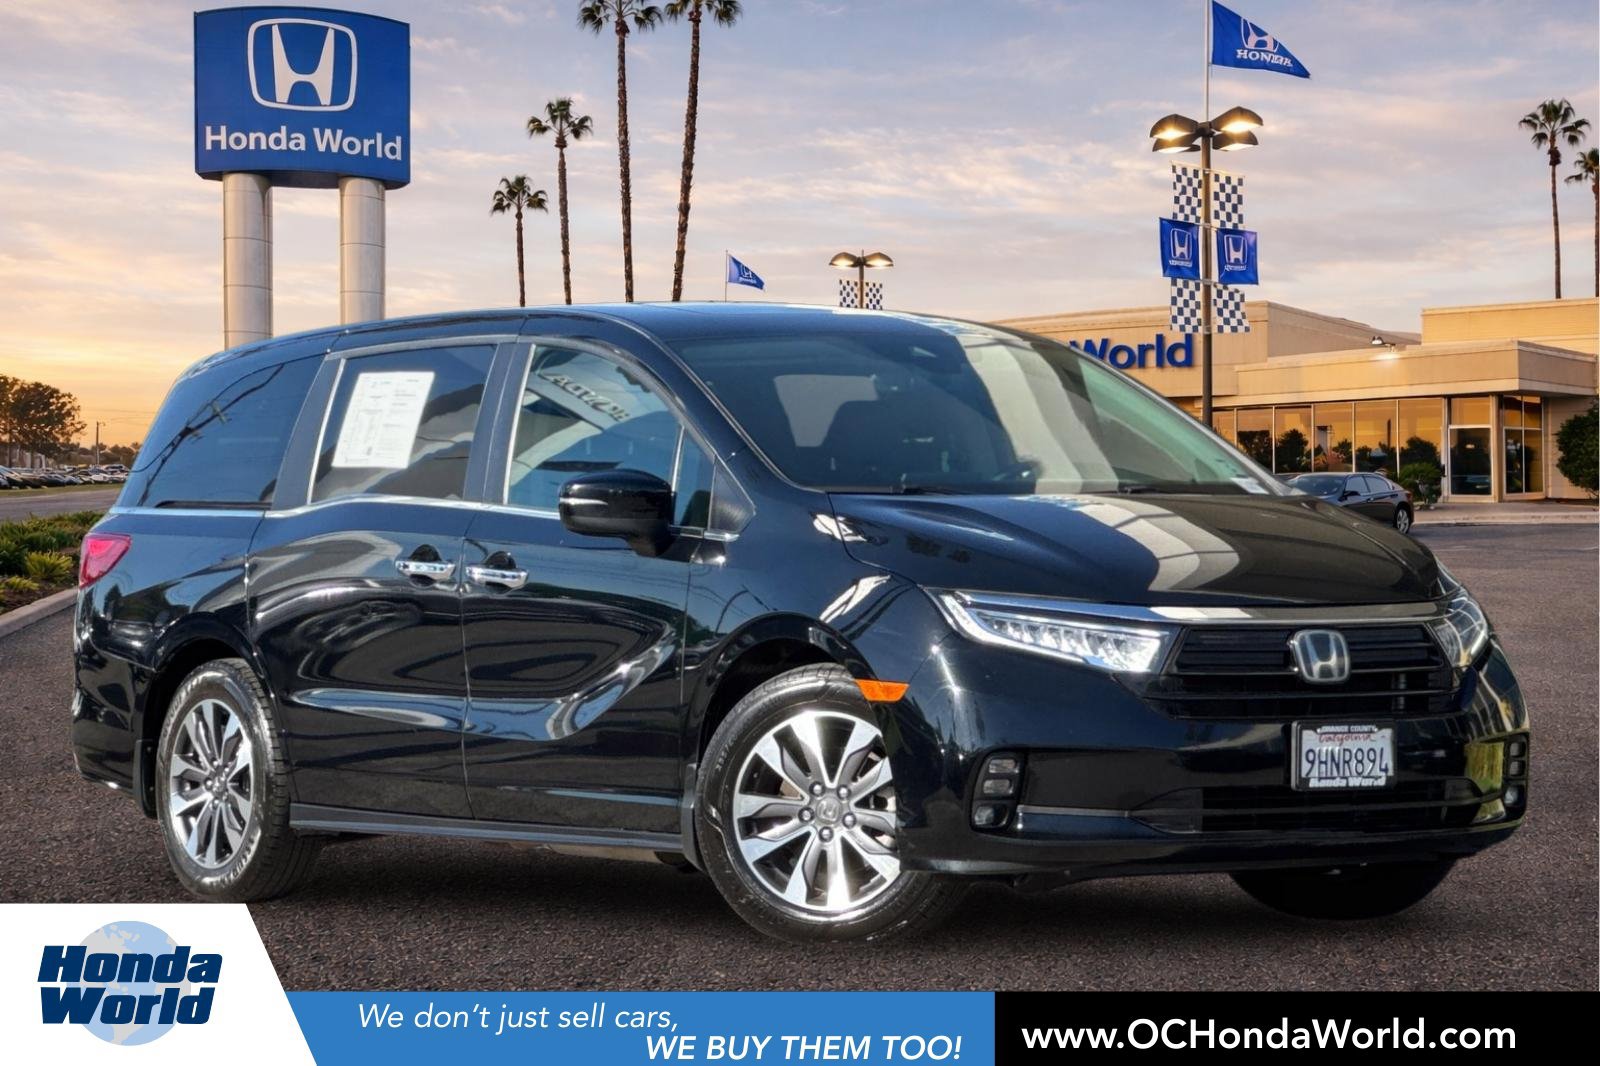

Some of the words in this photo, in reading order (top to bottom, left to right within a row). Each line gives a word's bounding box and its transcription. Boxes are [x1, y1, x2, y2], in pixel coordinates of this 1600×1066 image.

[205, 125, 306, 151] Honda
[313, 127, 402, 161] World
[1305, 747, 1389, 777] 9HNR894
